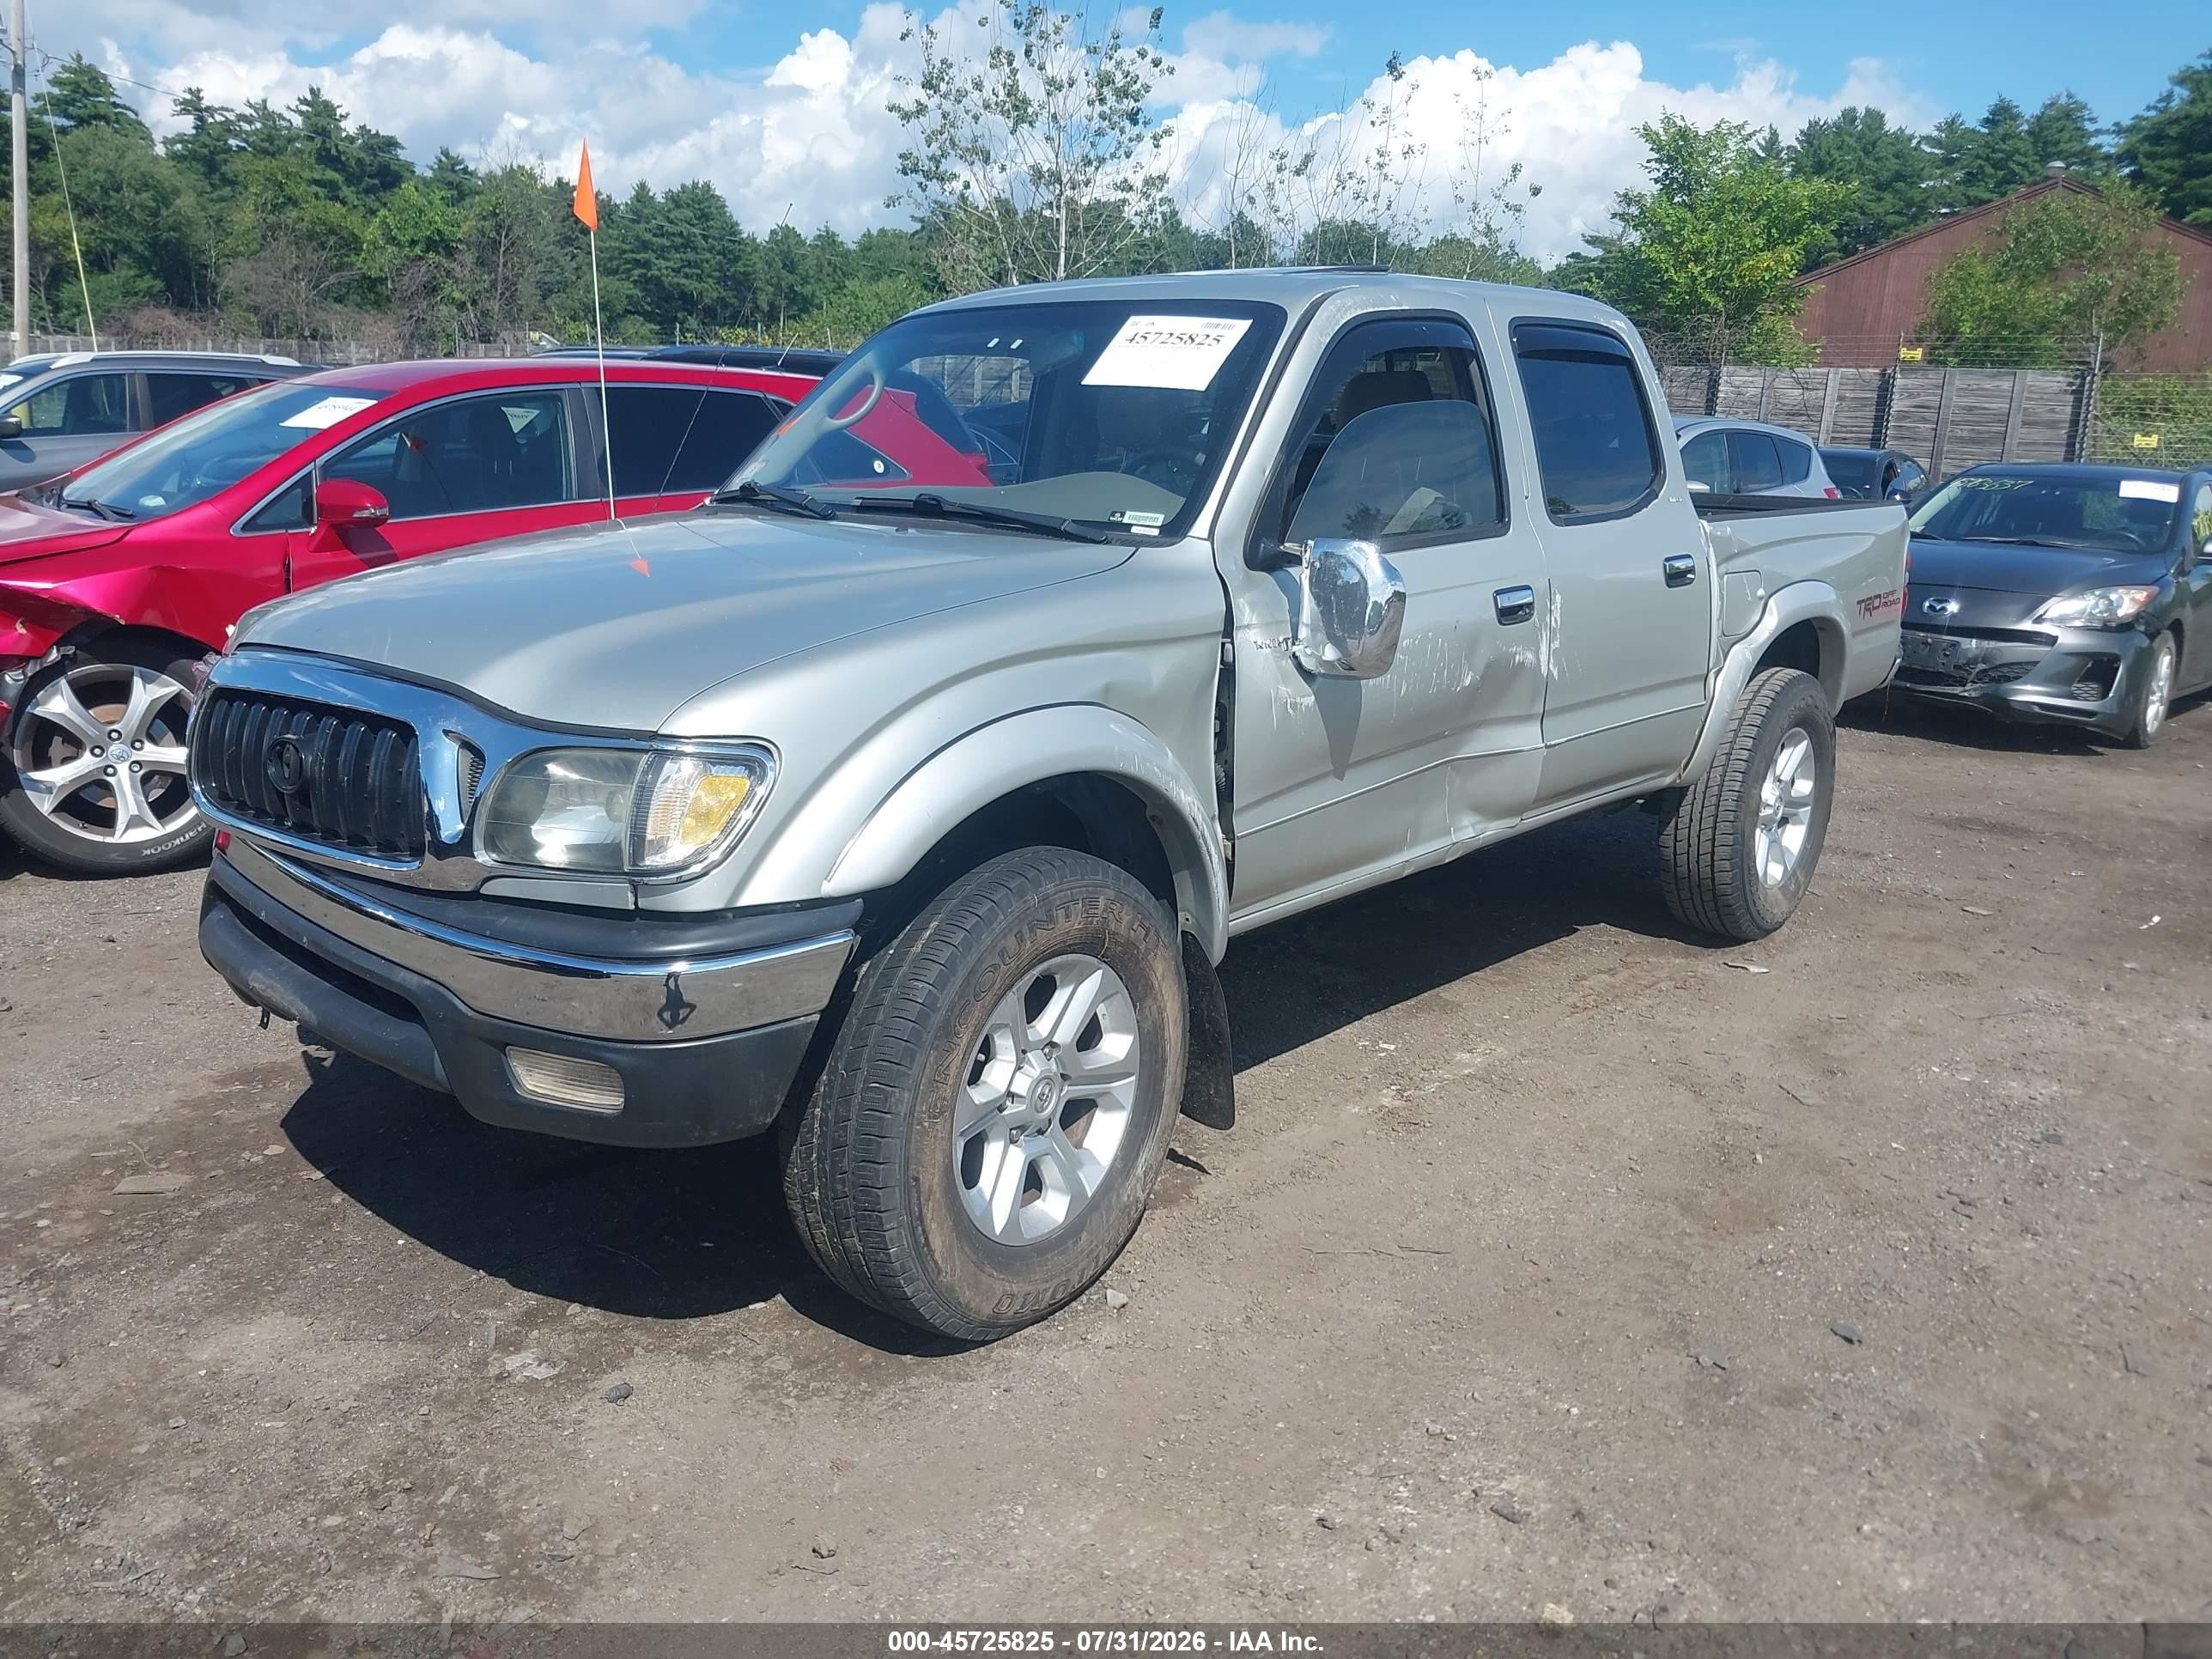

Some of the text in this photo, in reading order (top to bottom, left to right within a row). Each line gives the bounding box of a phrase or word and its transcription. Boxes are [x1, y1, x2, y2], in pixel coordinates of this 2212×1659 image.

[1124, 331, 1226, 347] 45725825
[1882, 589, 1898, 599] OFF
[1856, 593, 1882, 620] TRD
[1881, 597, 1901, 609] ROAD
[926, 896, 1124, 1122] ENCOUNTER
